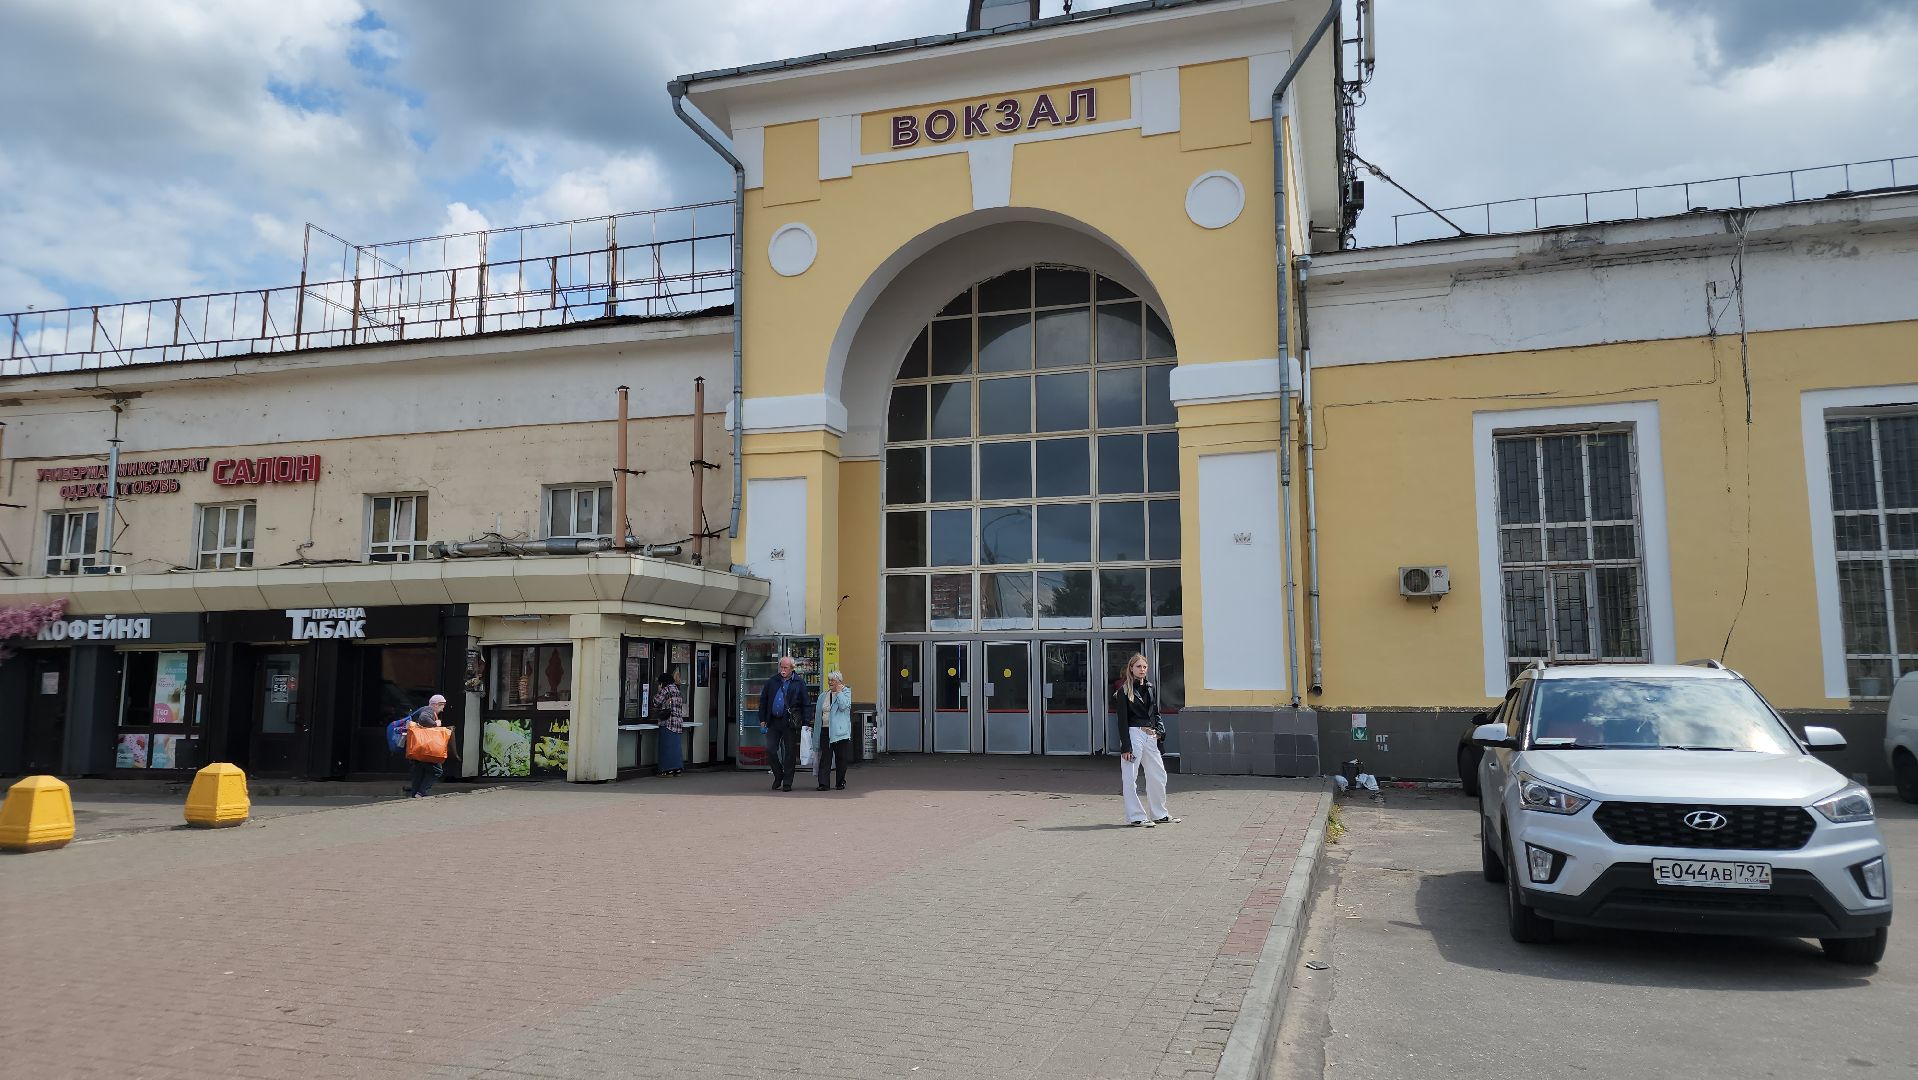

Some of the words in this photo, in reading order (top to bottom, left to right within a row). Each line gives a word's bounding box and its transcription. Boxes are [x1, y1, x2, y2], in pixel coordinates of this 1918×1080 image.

[891, 87, 1096, 148] ВОКЗАЛ
[37, 464, 109, 481] УНИВЕРМА
[213, 455, 320, 485] САЛОН
[133, 479, 180, 494] ОБУВЬ
[311, 607, 367, 620] ПРАВДА
[285, 609, 367, 640] ТАБАК
[1659, 863, 1732, 880] Е044АВ
[1736, 864, 1765, 878] 797
